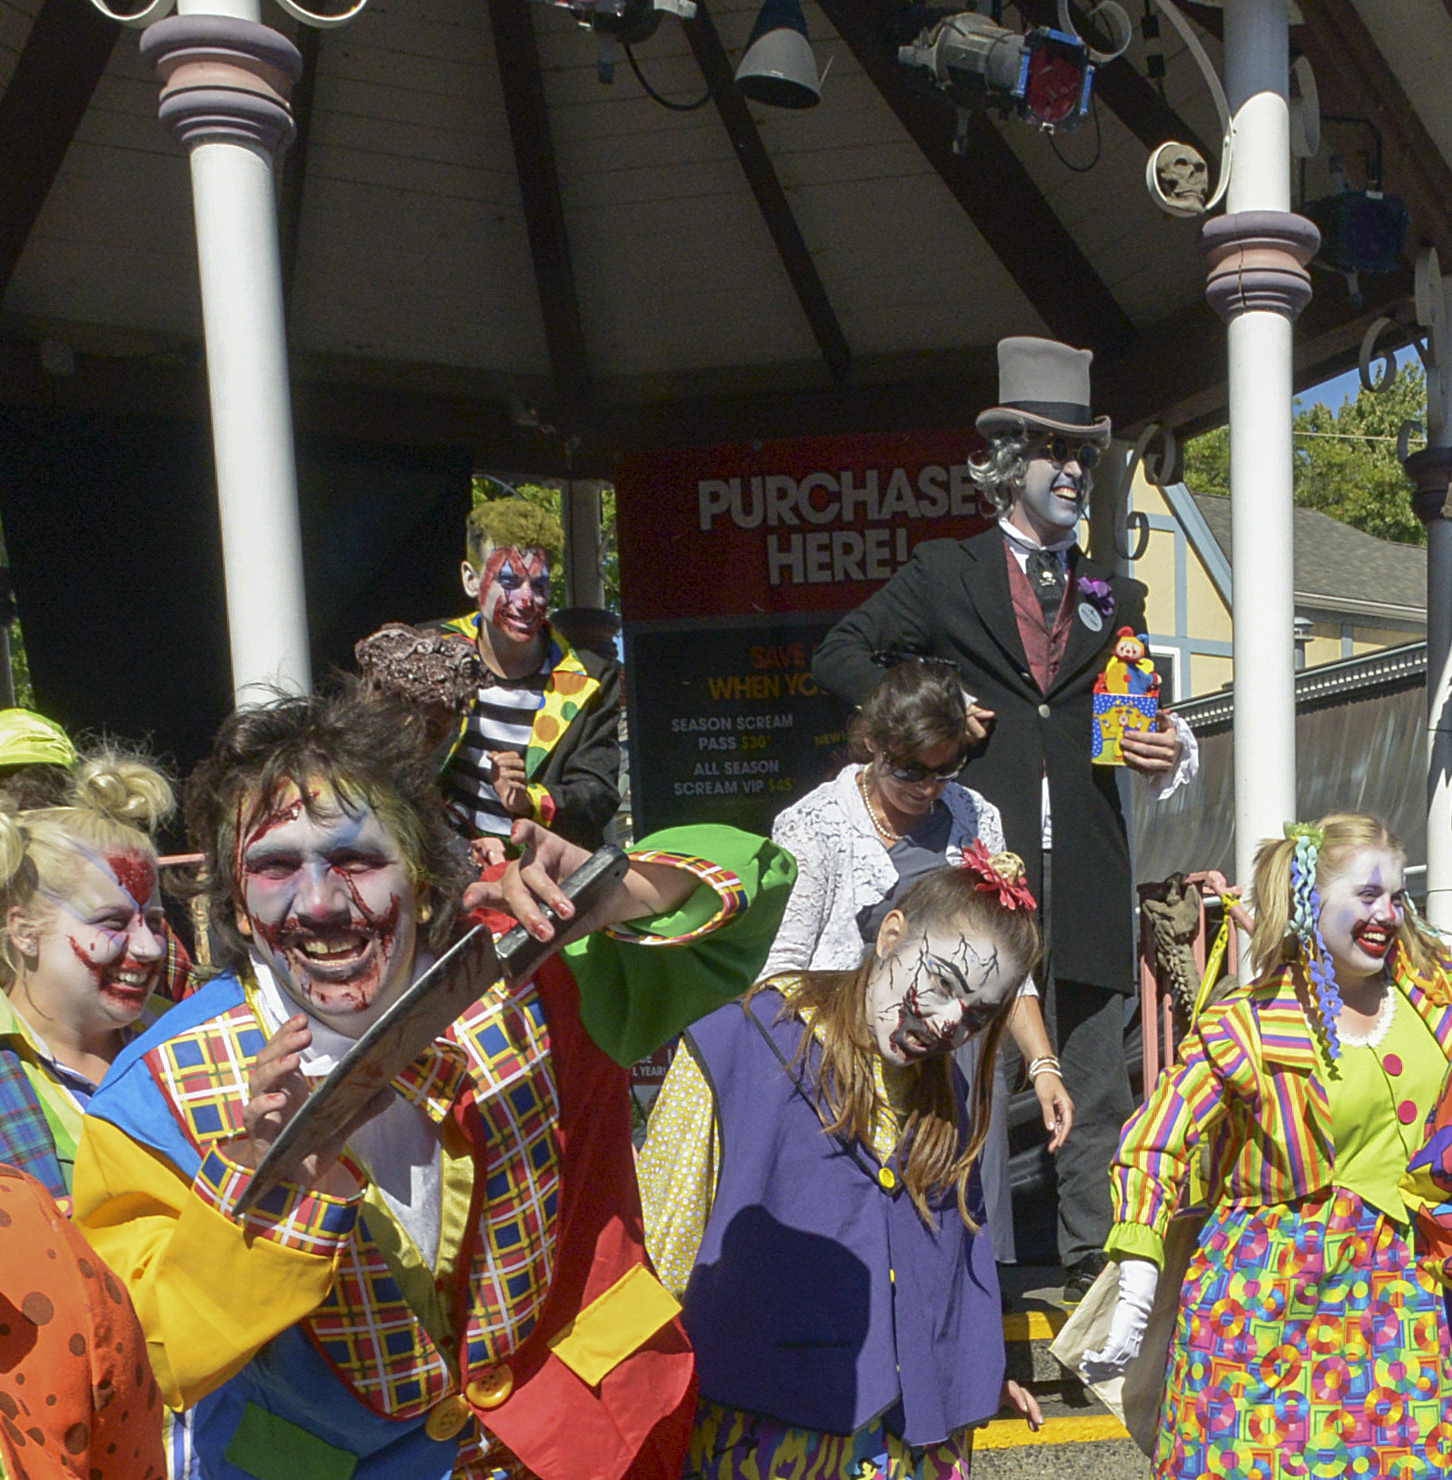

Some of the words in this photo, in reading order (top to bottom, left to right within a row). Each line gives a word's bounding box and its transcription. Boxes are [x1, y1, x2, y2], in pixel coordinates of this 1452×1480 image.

[699, 465, 978, 531] PURCHASE
[767, 527, 908, 585] HERE!
[749, 643, 805, 669] SAVE
[707, 673, 782, 699] WHEN
[784, 671, 831, 696] YO
[671, 718, 732, 732] SEASON
[736, 713, 793, 730] SCREAM
[699, 736, 737, 750] PASS
[694, 762, 720, 776] ALL
[724, 759, 779, 775] SEASON
[674, 781, 738, 796] SCREAM
[742, 779, 765, 793] VIP
